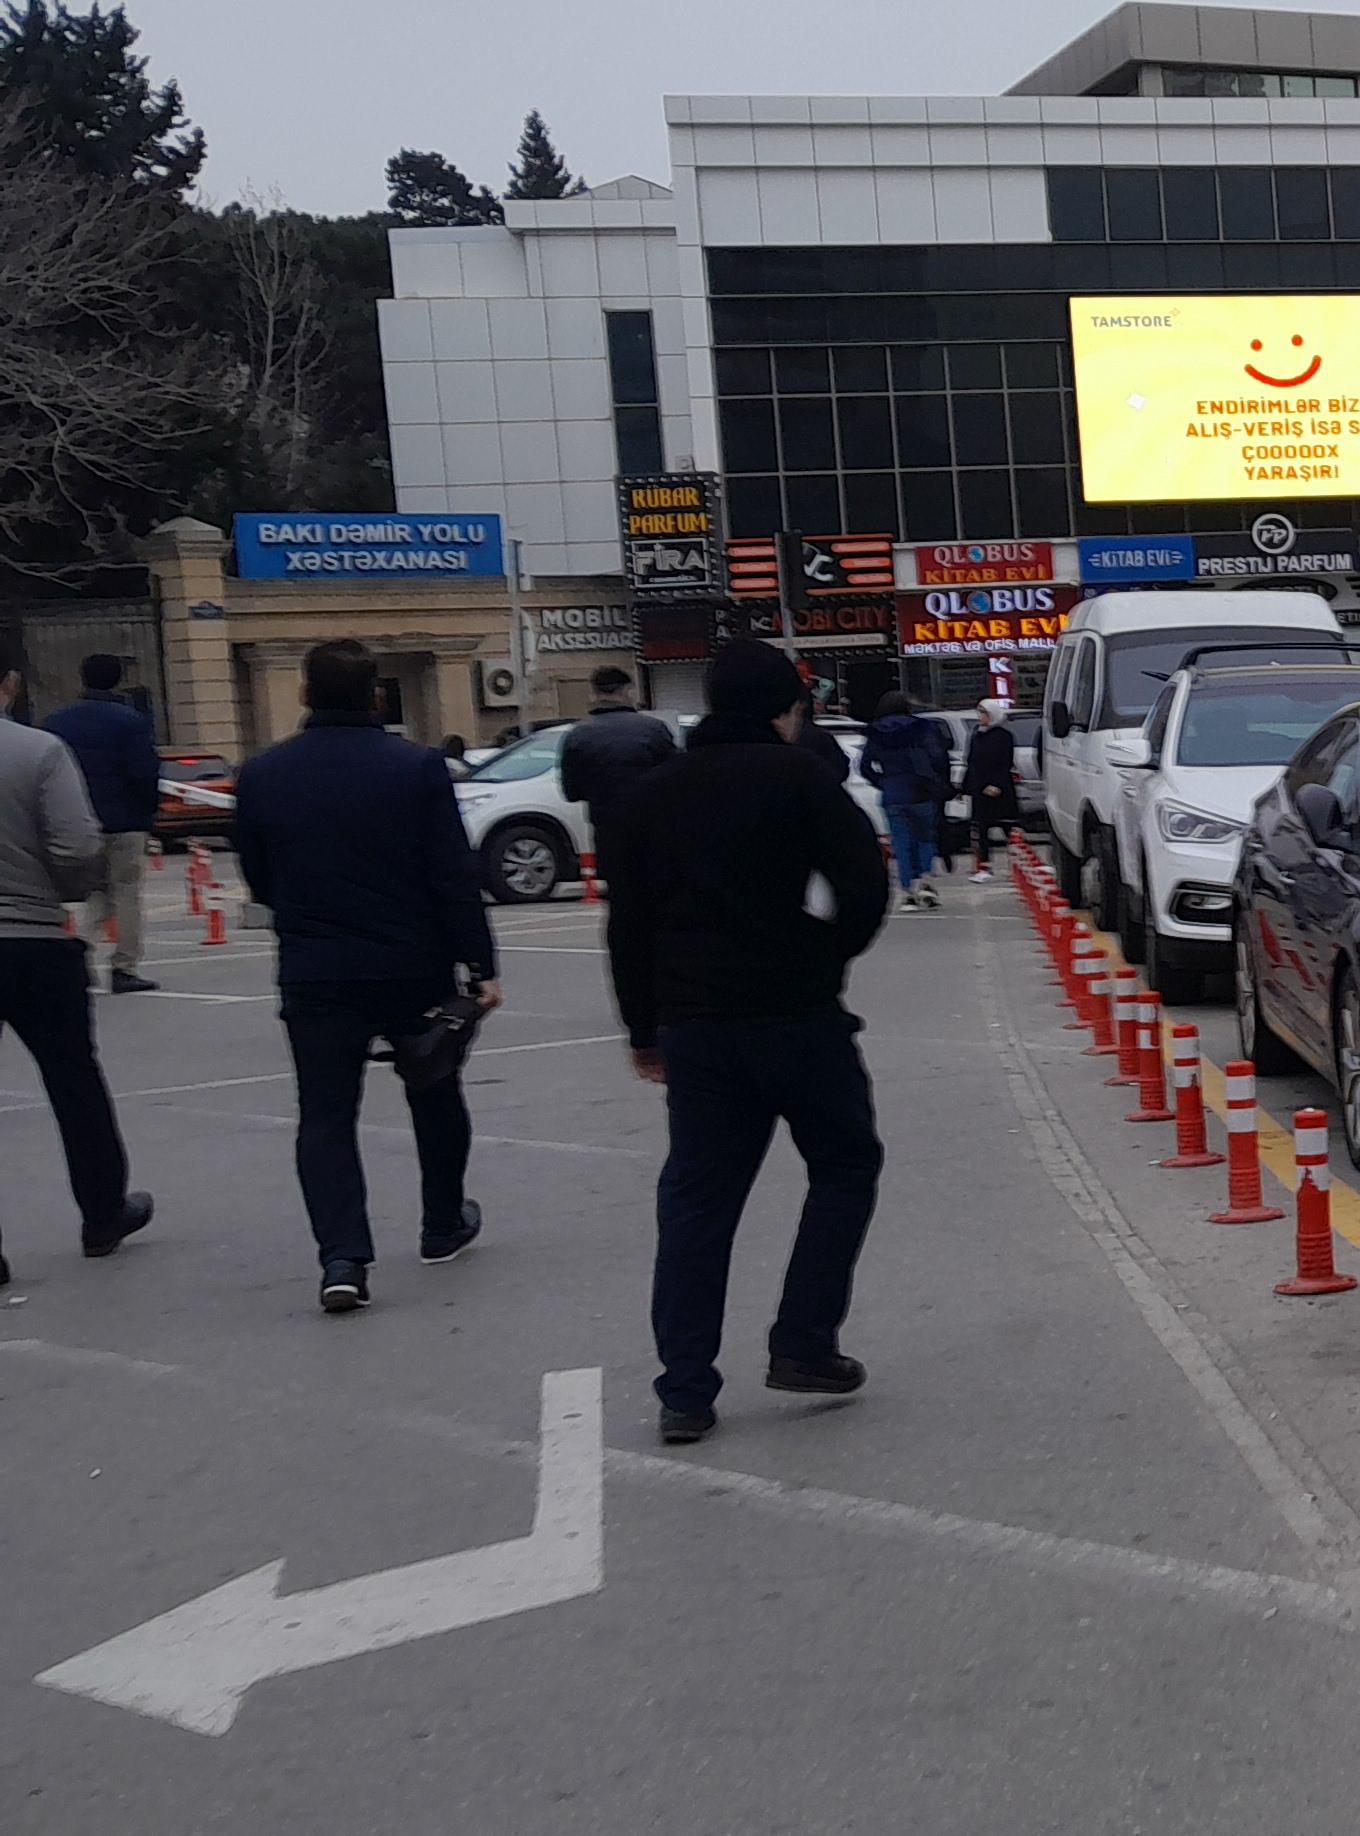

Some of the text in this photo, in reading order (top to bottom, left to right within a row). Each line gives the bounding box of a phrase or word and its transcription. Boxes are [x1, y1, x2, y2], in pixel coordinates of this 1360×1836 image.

[1091, 315, 1173, 328] TAMSTORE
[1197, 397, 1321, 415] ENDİRİMLƏR
[1186, 418, 1303, 439] ALIŞ-VERİŞ
[1311, 418, 1342, 435] İSƏ
[1242, 444, 1339, 463] ÇOOOOOX
[1244, 465, 1339, 482] YARAŞIR!
[631, 485, 700, 509] RÜBAR
[258, 520, 485, 543] BAKI DƏMİR YOLU
[629, 512, 708, 534] PARFUM
[286, 550, 468, 571] XƏSTƏXANASI
[1277, 553, 1352, 573] PARFUM
[925, 564, 1046, 583] KİTAB EVİ
[836, 607, 886, 629] CITY
[914, 619, 1011, 640] KİTAB
[538, 632, 639, 651] AKSESUAR
[963, 639, 981, 651] VƏ
[1018, 637, 1058, 648] MALL
